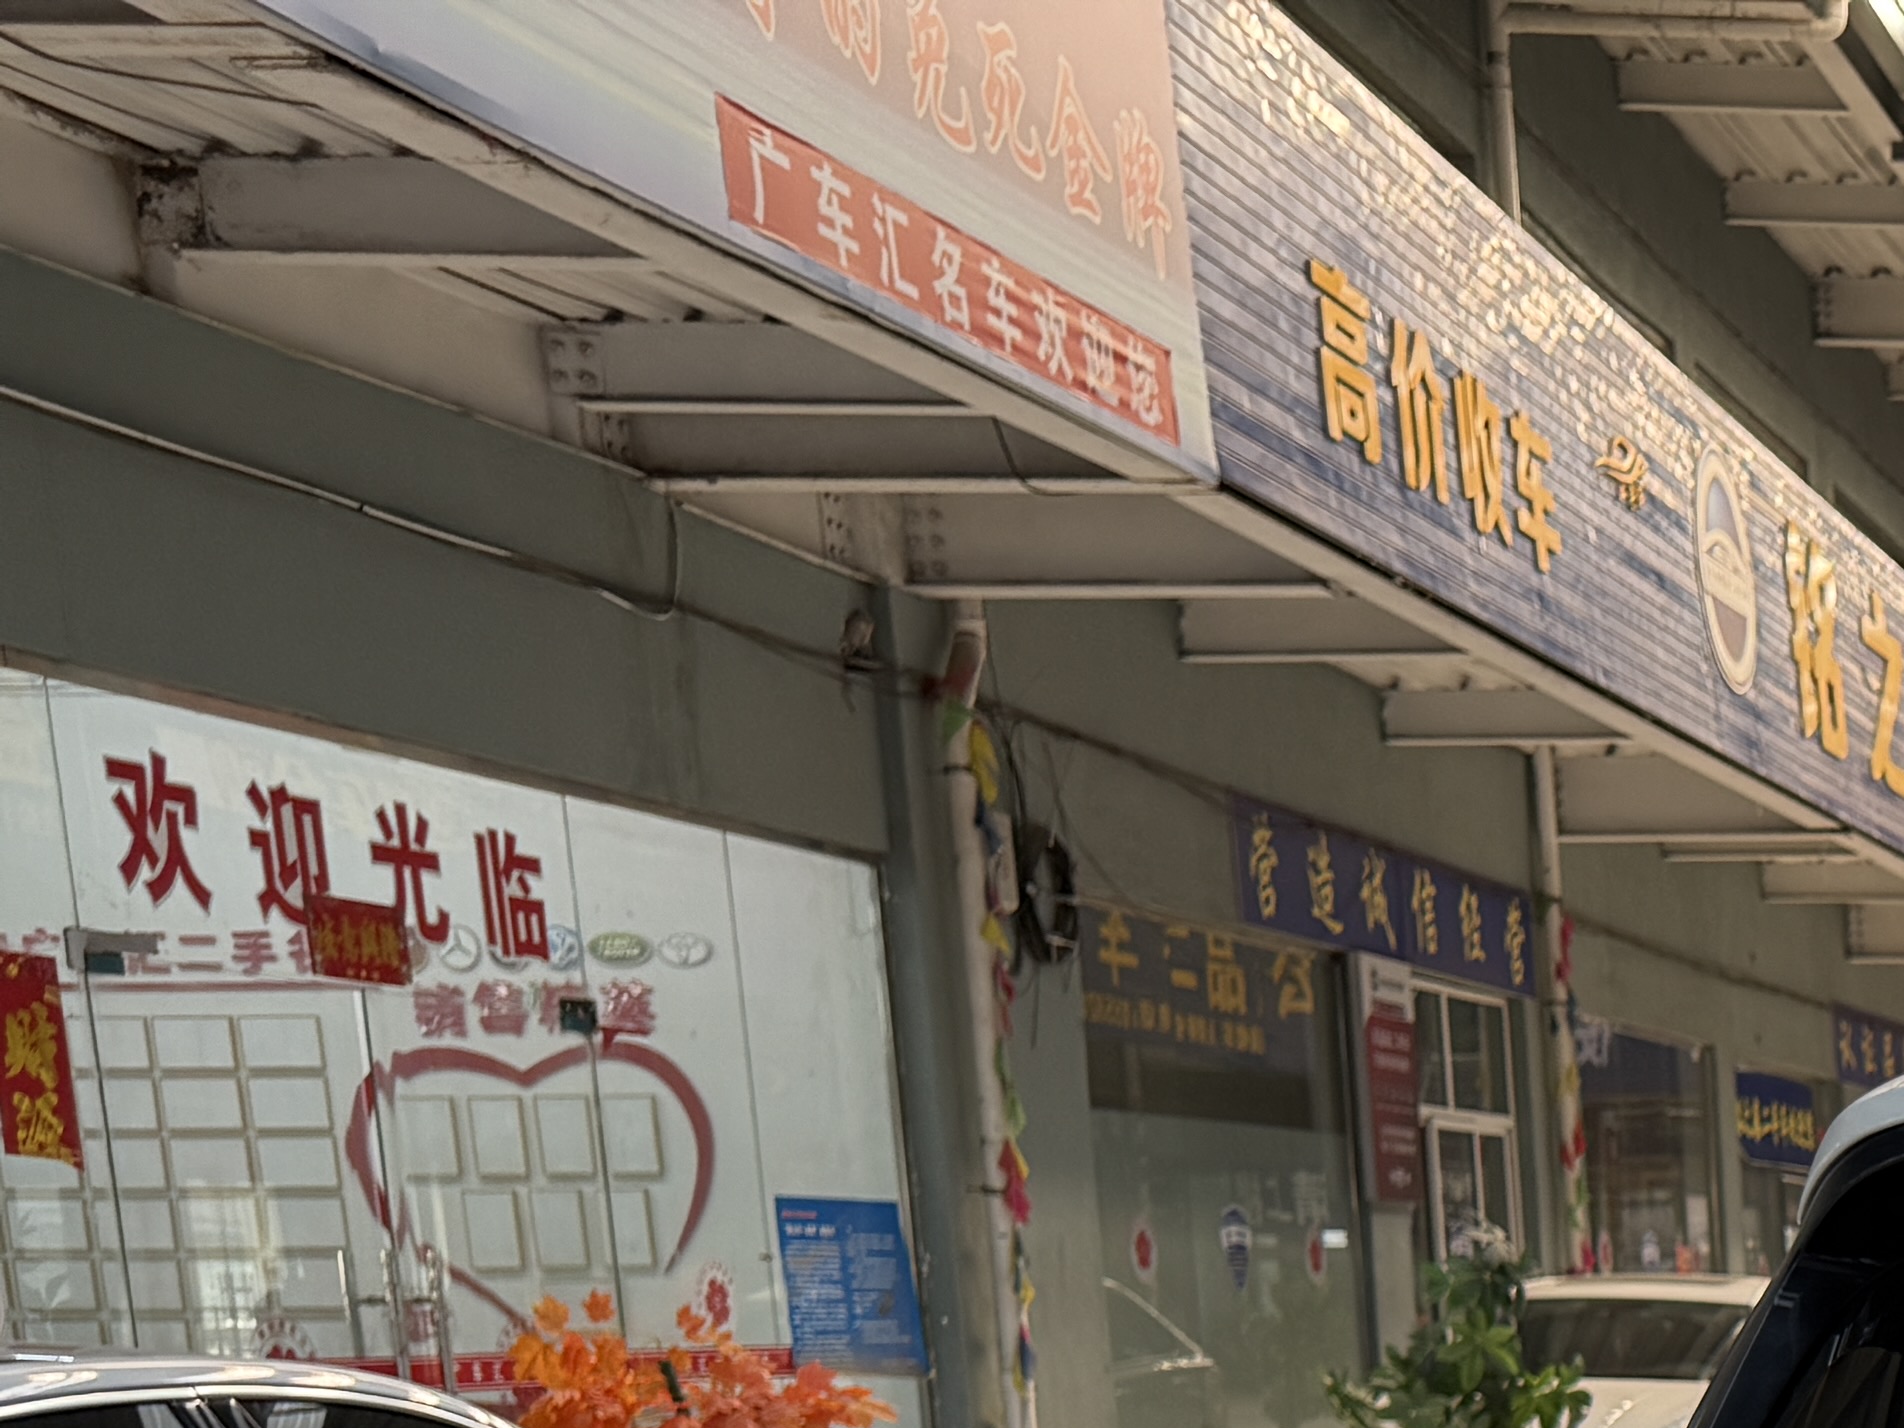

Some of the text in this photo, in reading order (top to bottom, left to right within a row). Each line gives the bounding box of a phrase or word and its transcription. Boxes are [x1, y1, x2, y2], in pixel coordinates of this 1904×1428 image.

[747, 126, 1164, 428] 广车汇名车欢迎您
[1309, 257, 1563, 575] 高价收车
[104, 748, 551, 962] 欢迎光临
[1250, 811, 1526, 987] 营造诚信经营
